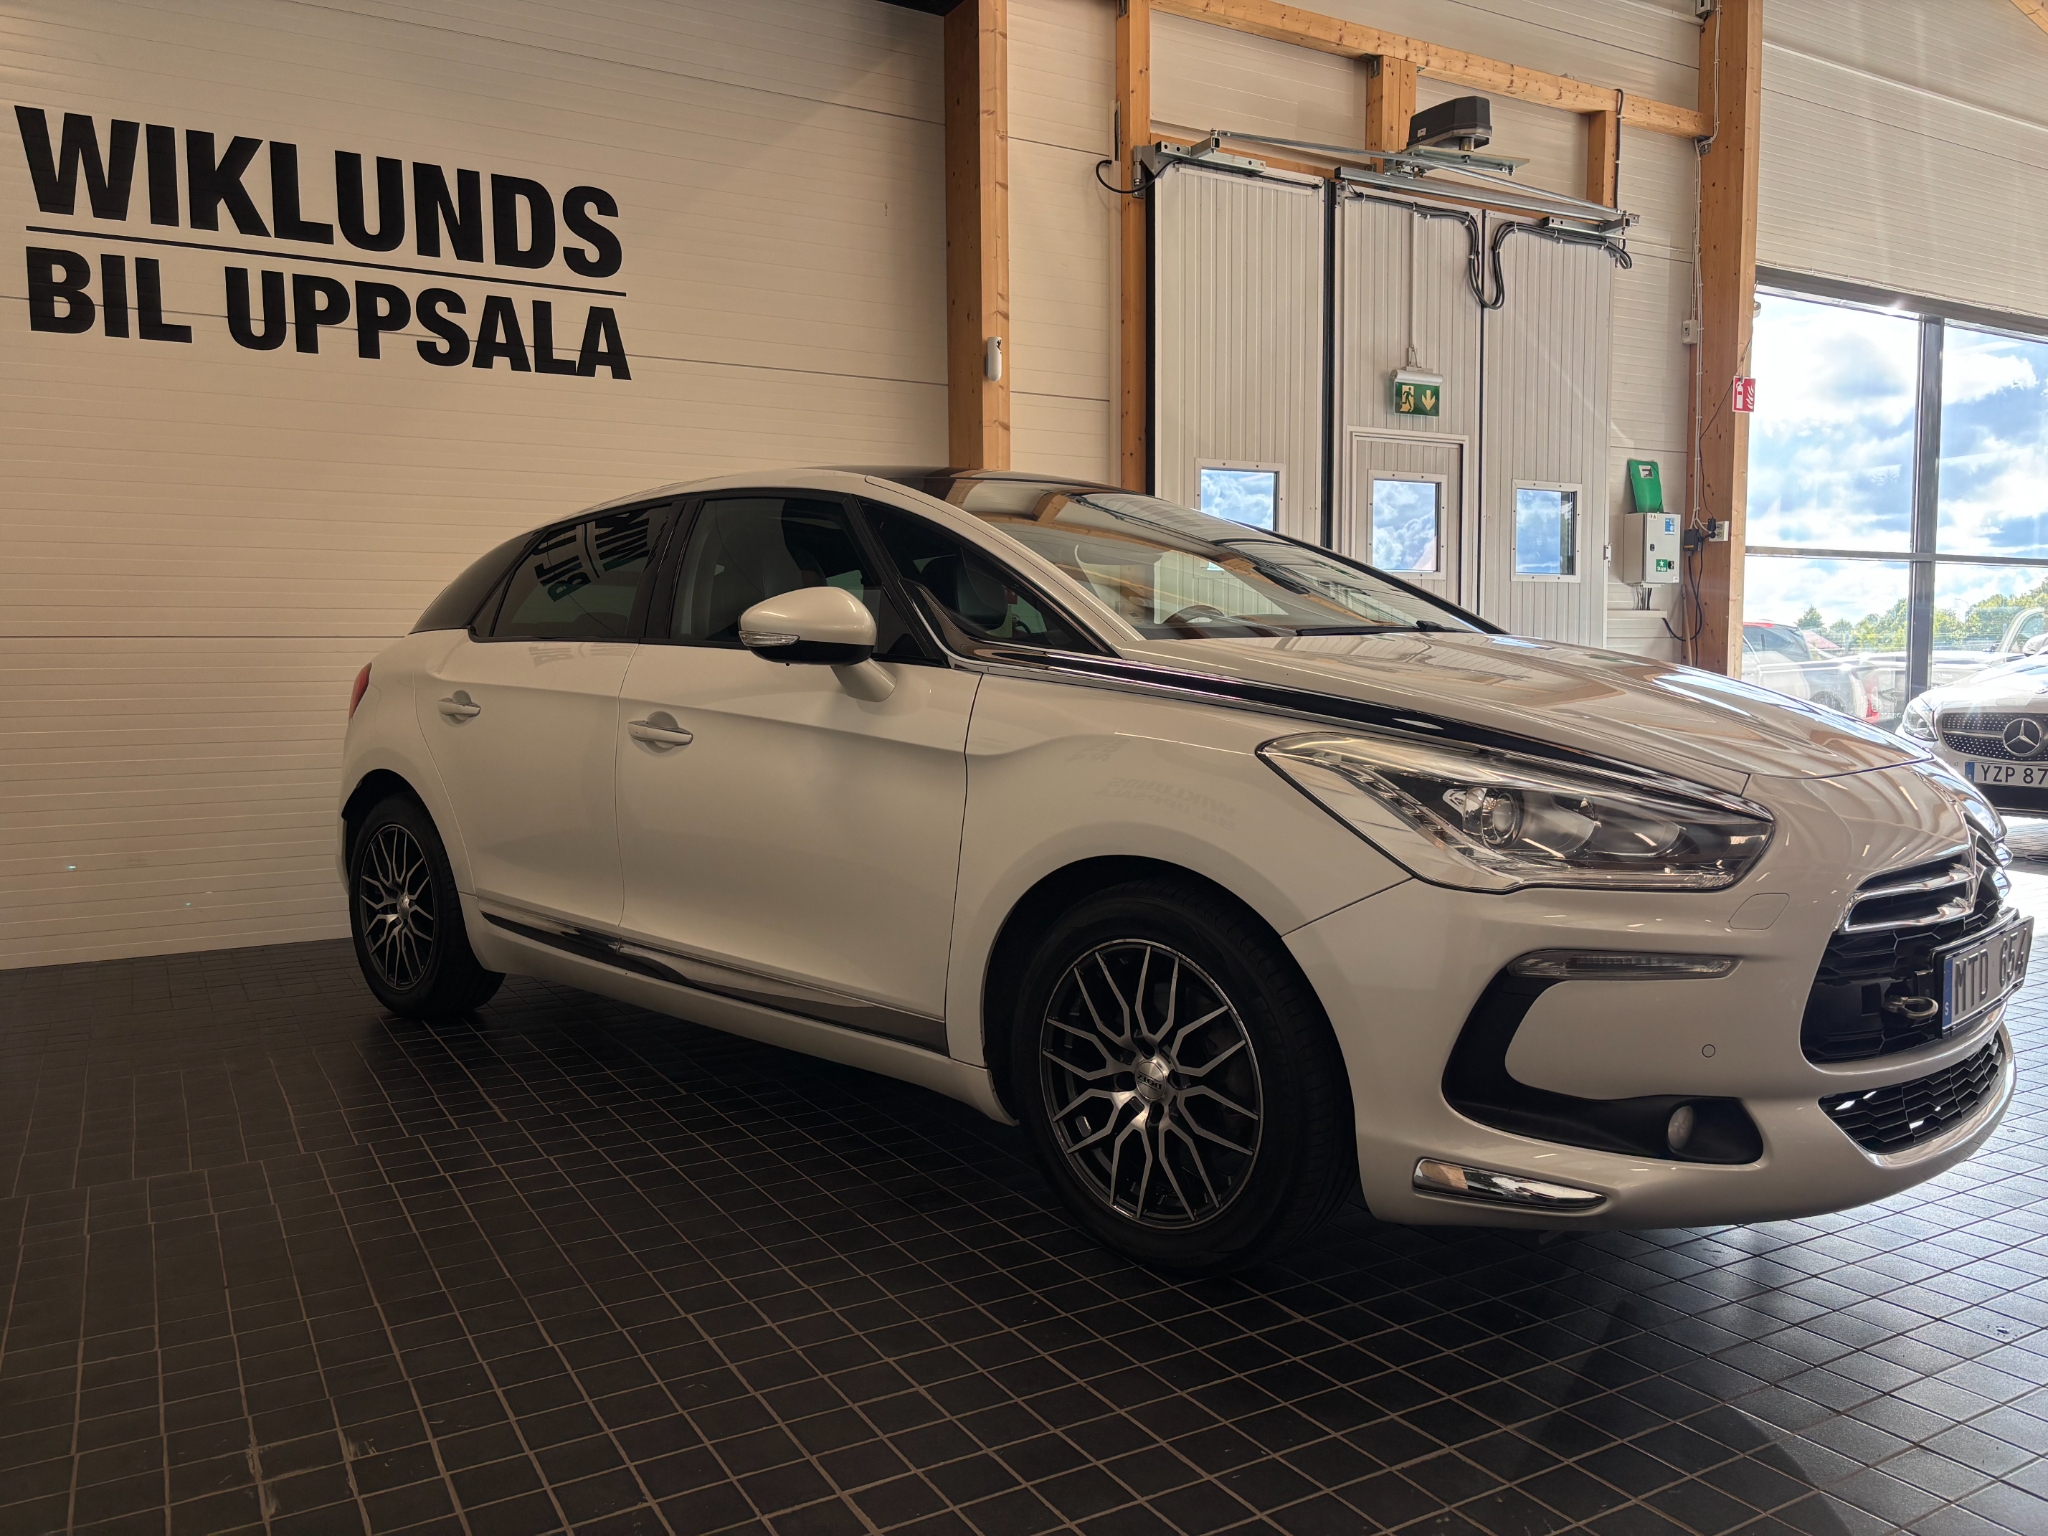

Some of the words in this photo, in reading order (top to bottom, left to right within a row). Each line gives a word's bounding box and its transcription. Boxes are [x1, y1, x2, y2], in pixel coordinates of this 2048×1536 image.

[14, 105, 623, 278] WIKLUNDS
[26, 245, 192, 343] BIL
[224, 266, 632, 380] UPPSALA
[1980, 764, 2016, 783] YZP
[2022, 767, 2048, 785] 87
[1955, 948, 1988, 1016] MTD
[1999, 927, 2027, 988] 654
